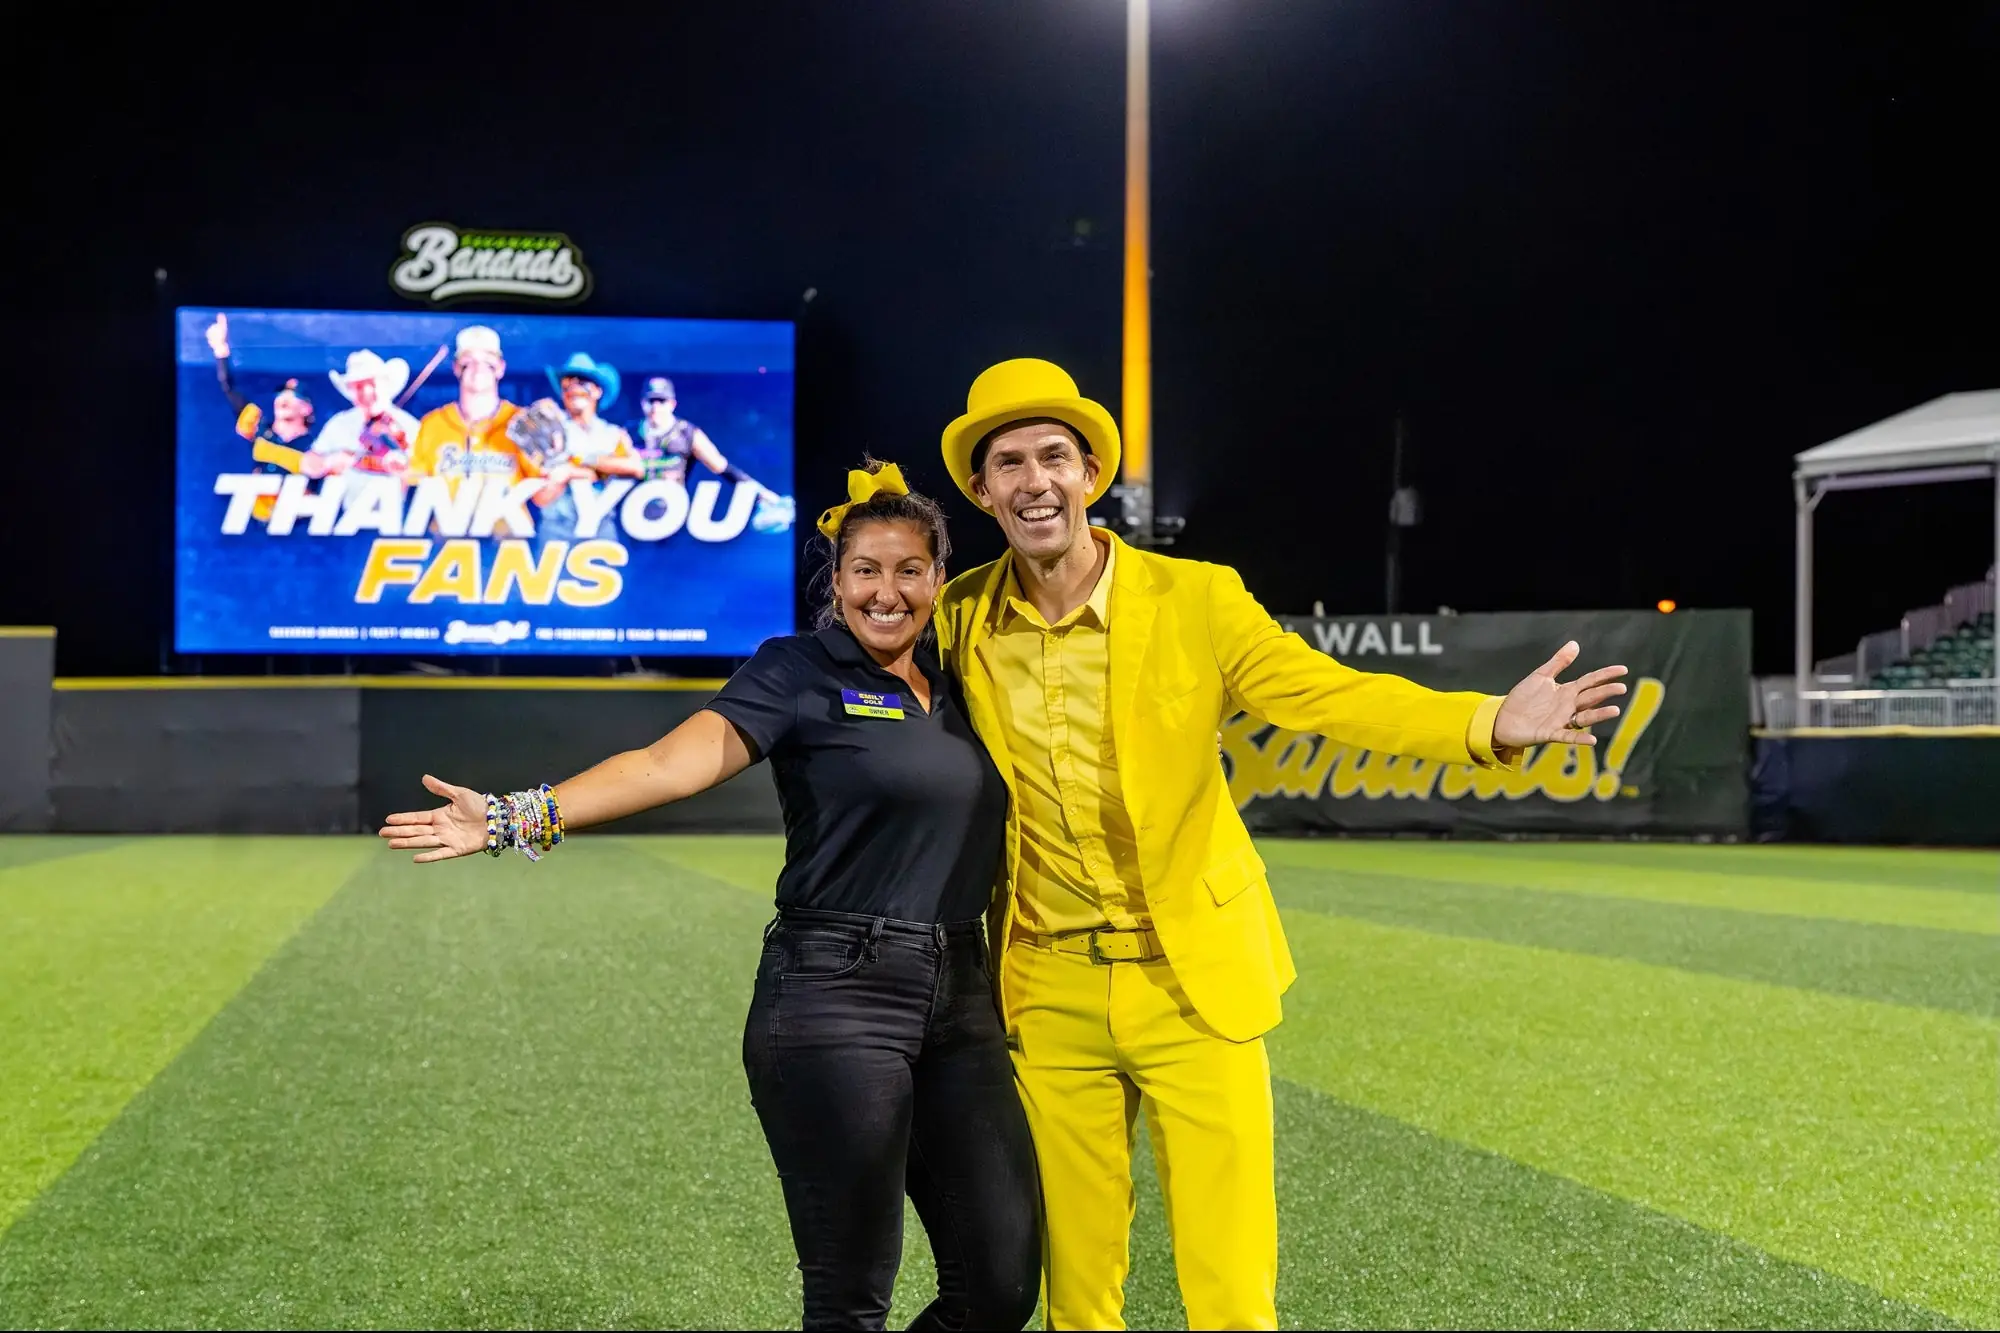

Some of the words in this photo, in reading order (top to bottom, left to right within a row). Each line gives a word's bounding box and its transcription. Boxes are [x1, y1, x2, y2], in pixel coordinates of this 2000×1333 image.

[394, 226, 585, 300] Bananas
[214, 474, 548, 536] THANK
[570, 478, 757, 542] YOU
[354, 538, 629, 607] FANS
[1312, 621, 1444, 656] WALL
[858, 693, 885, 701] EMILY
